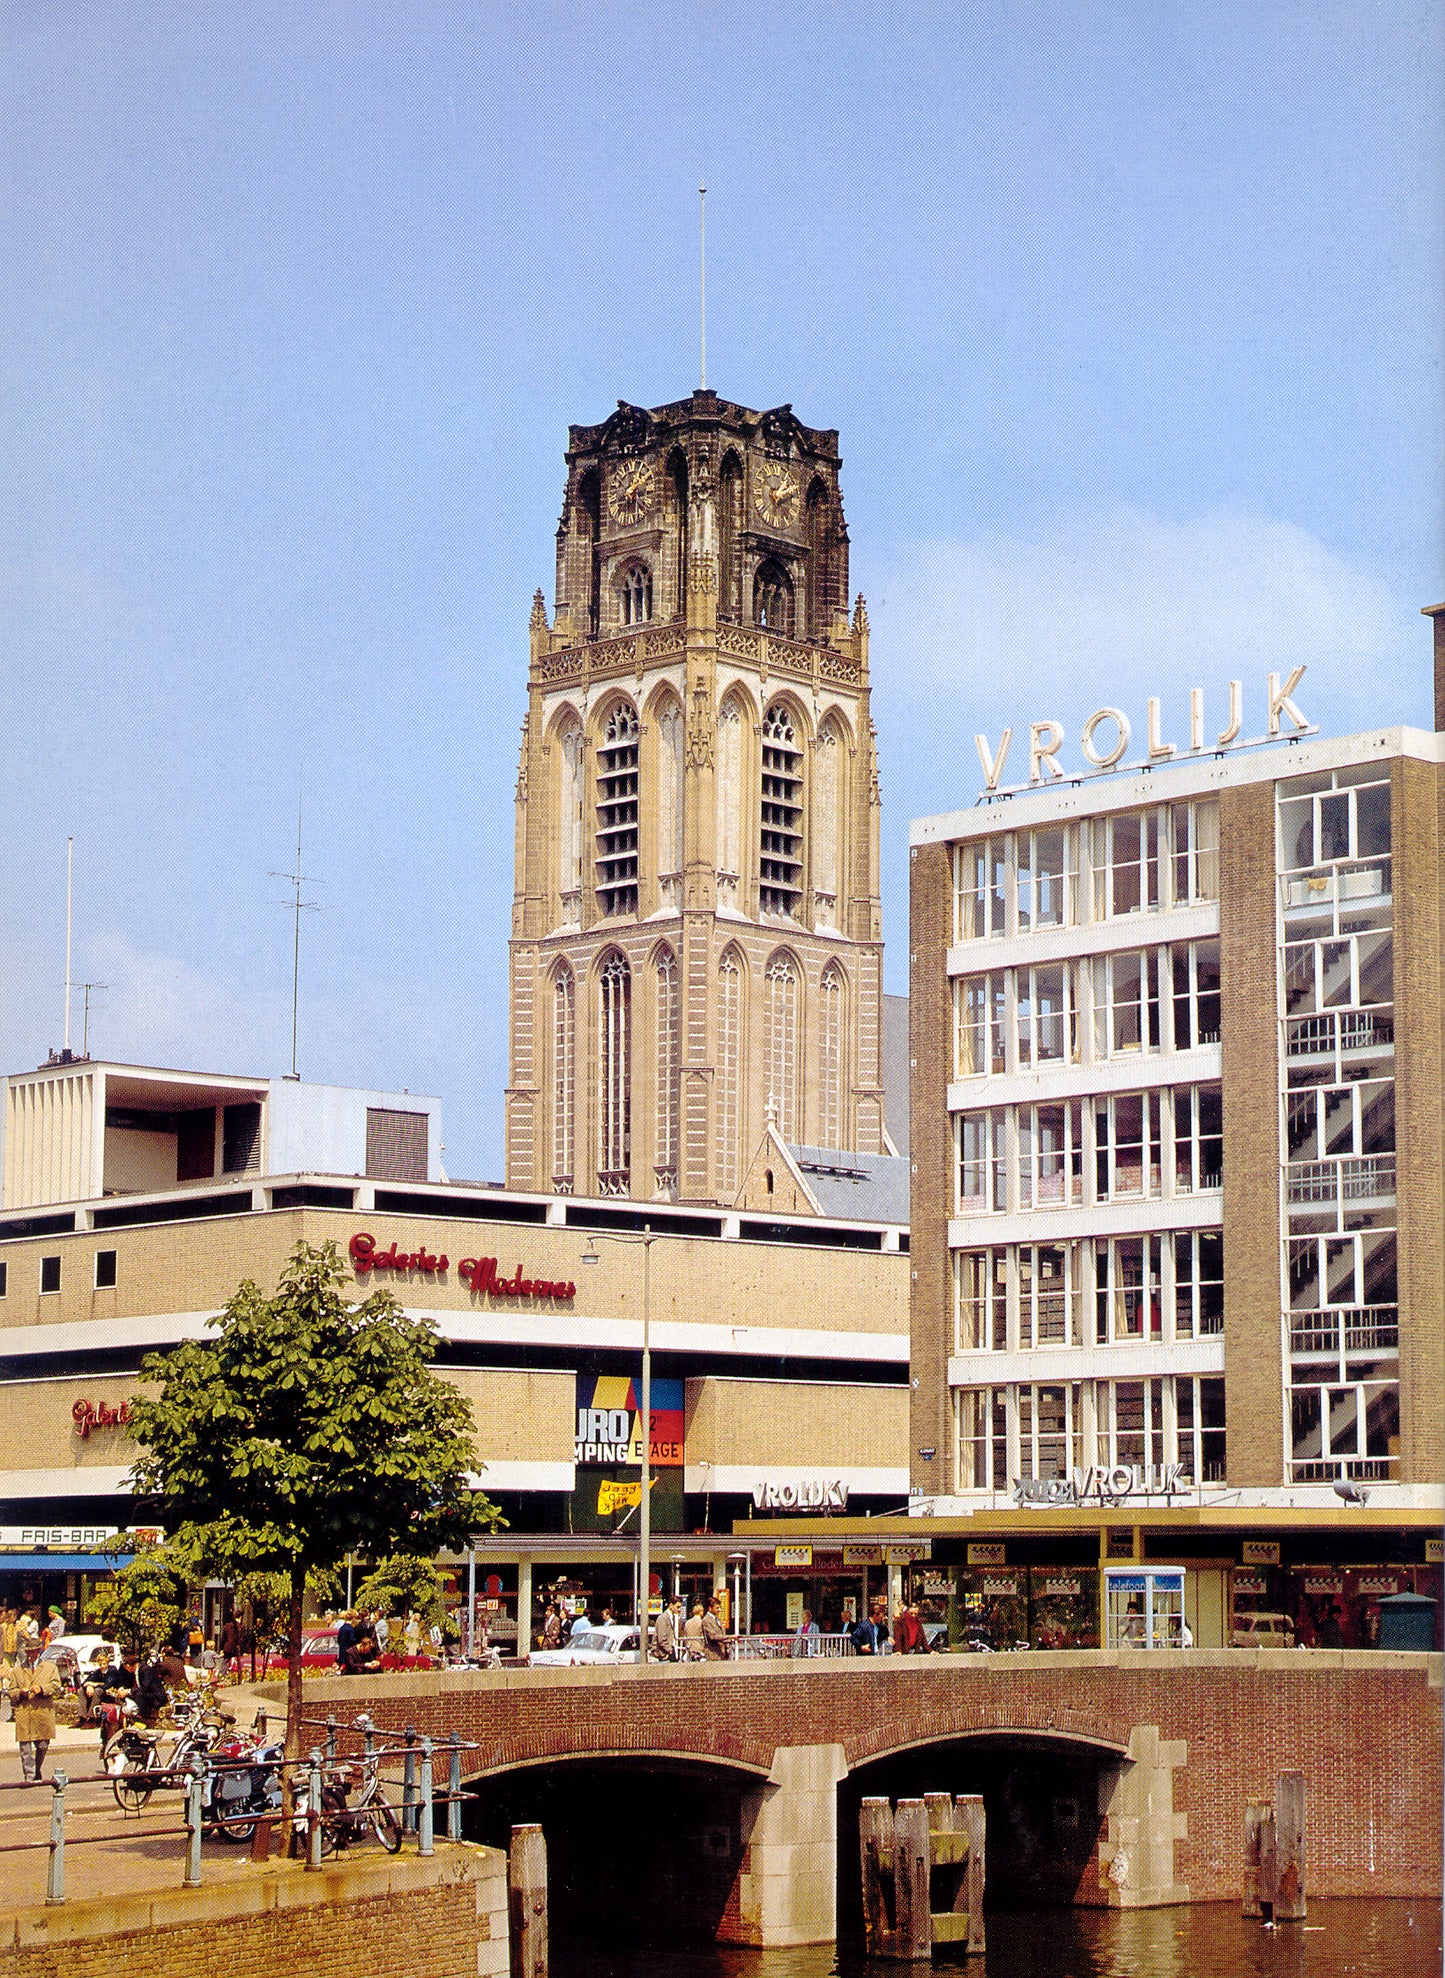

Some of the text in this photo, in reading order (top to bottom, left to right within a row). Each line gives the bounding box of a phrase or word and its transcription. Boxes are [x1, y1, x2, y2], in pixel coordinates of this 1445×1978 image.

[974, 665, 1309, 790] VROLIJK
[350, 1232, 577, 1299] Galeries Modernes
[635, 1441, 679, 1458] EAGE
[753, 1480, 844, 1509] VROLIJK
[1073, 1463, 1187, 1496] VROLIJK
[22, 1530, 107, 1542] FRIS-BAR
